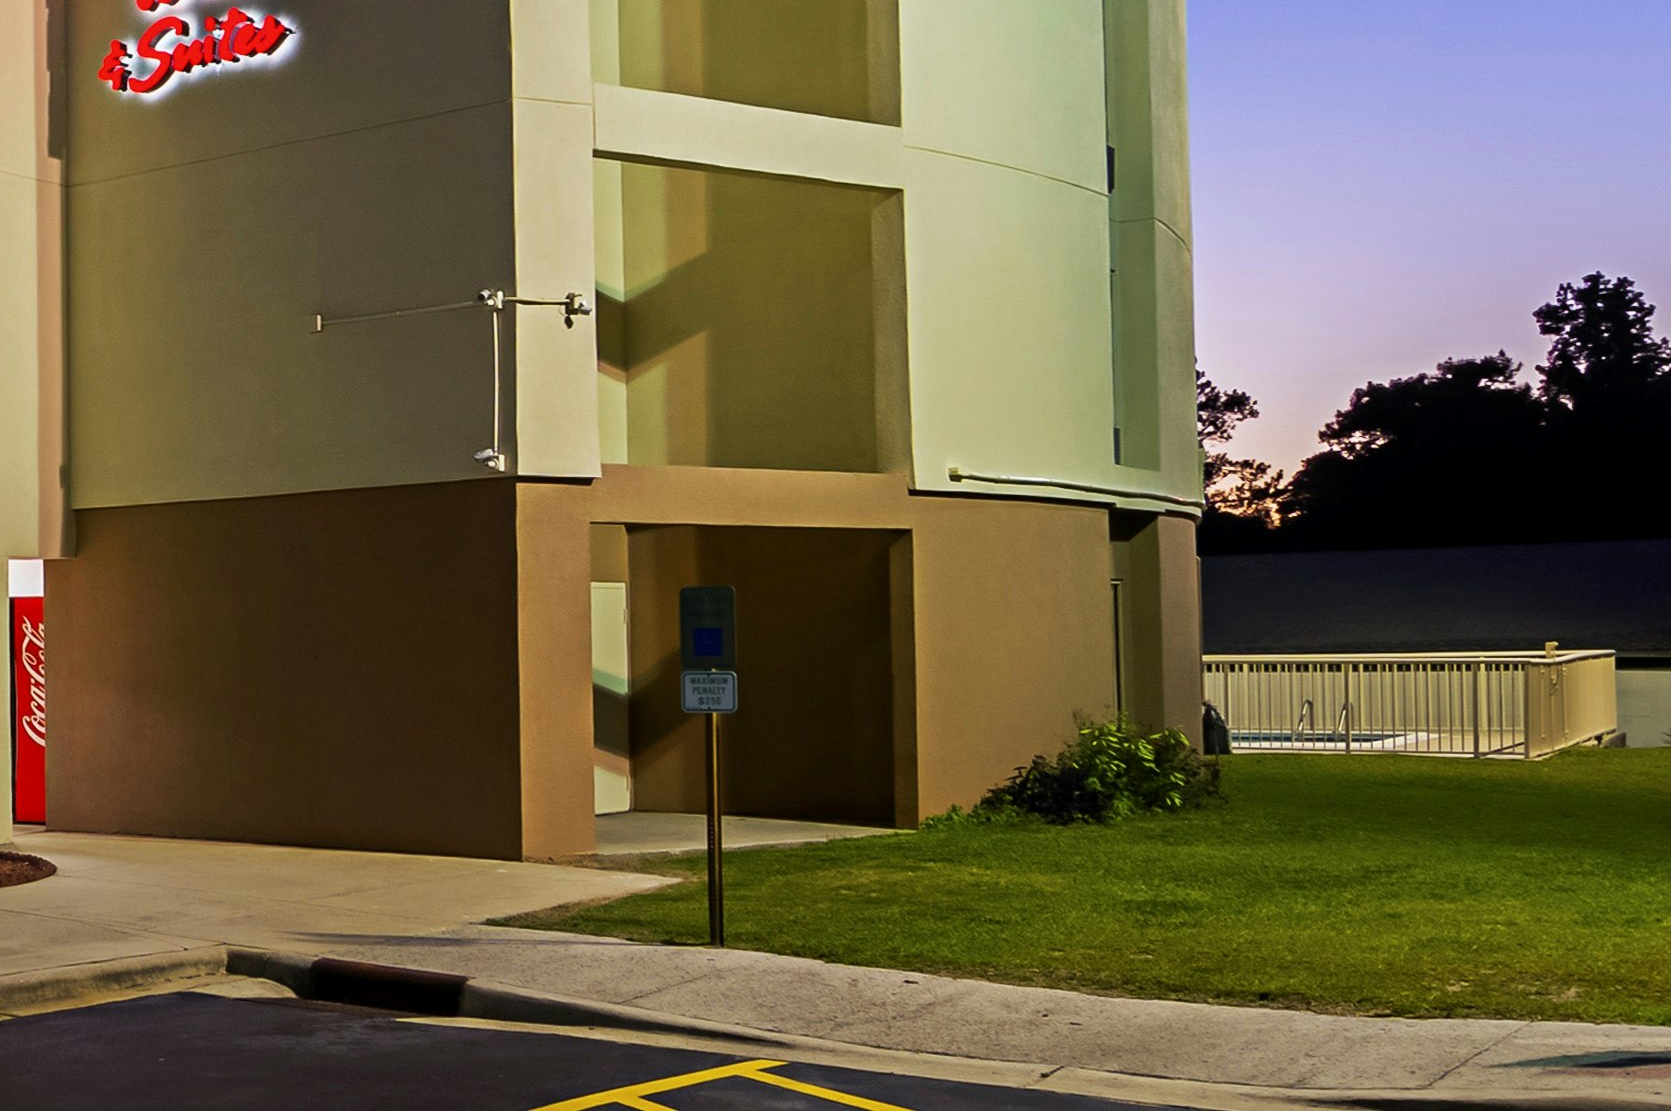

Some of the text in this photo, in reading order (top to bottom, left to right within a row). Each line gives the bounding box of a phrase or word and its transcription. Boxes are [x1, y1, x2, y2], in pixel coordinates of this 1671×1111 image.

[98, 7, 288, 93] & Suites
[690, 677, 728, 685] MAXIMUM
[692, 686, 726, 695] PENALTY
[697, 696, 722, 706] $250
